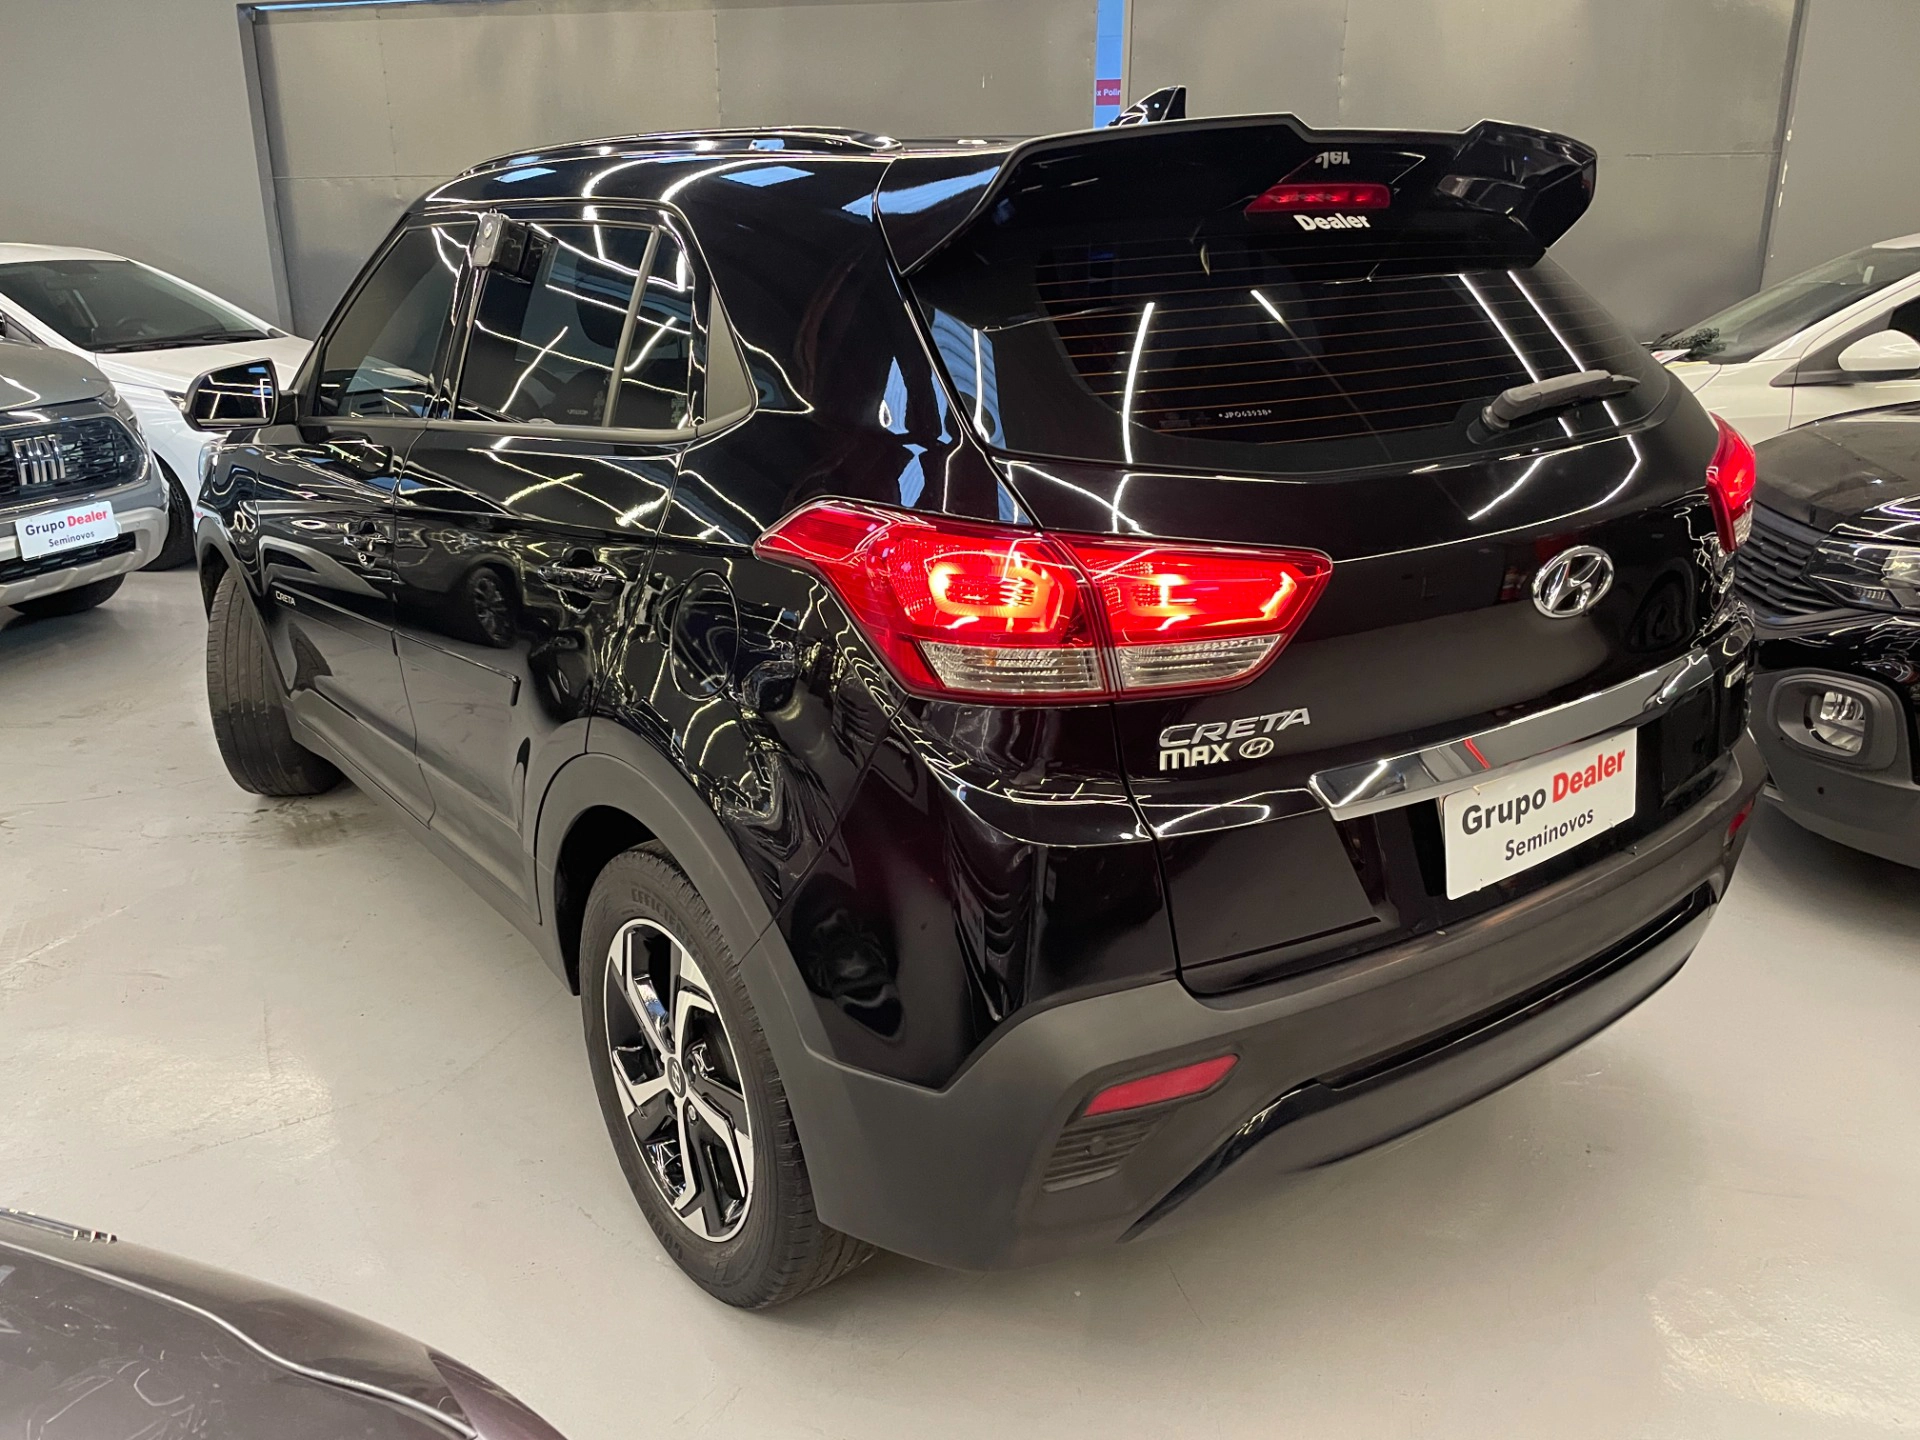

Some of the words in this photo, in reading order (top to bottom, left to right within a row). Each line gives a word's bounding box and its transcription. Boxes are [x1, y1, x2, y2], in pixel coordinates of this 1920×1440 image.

[1293, 212, 1371, 231] Dealer
[12, 434, 66, 486] FIAT
[25, 521, 66, 536] Grupo
[67, 510, 108, 528] Dealer
[48, 531, 95, 547] Seminovos
[1159, 707, 1311, 748] CRETA
[1159, 741, 1233, 772] MAX
[1462, 788, 1547, 835] Grupo
[1552, 749, 1626, 803] Dealer
[1505, 809, 1594, 861] Seminovos
